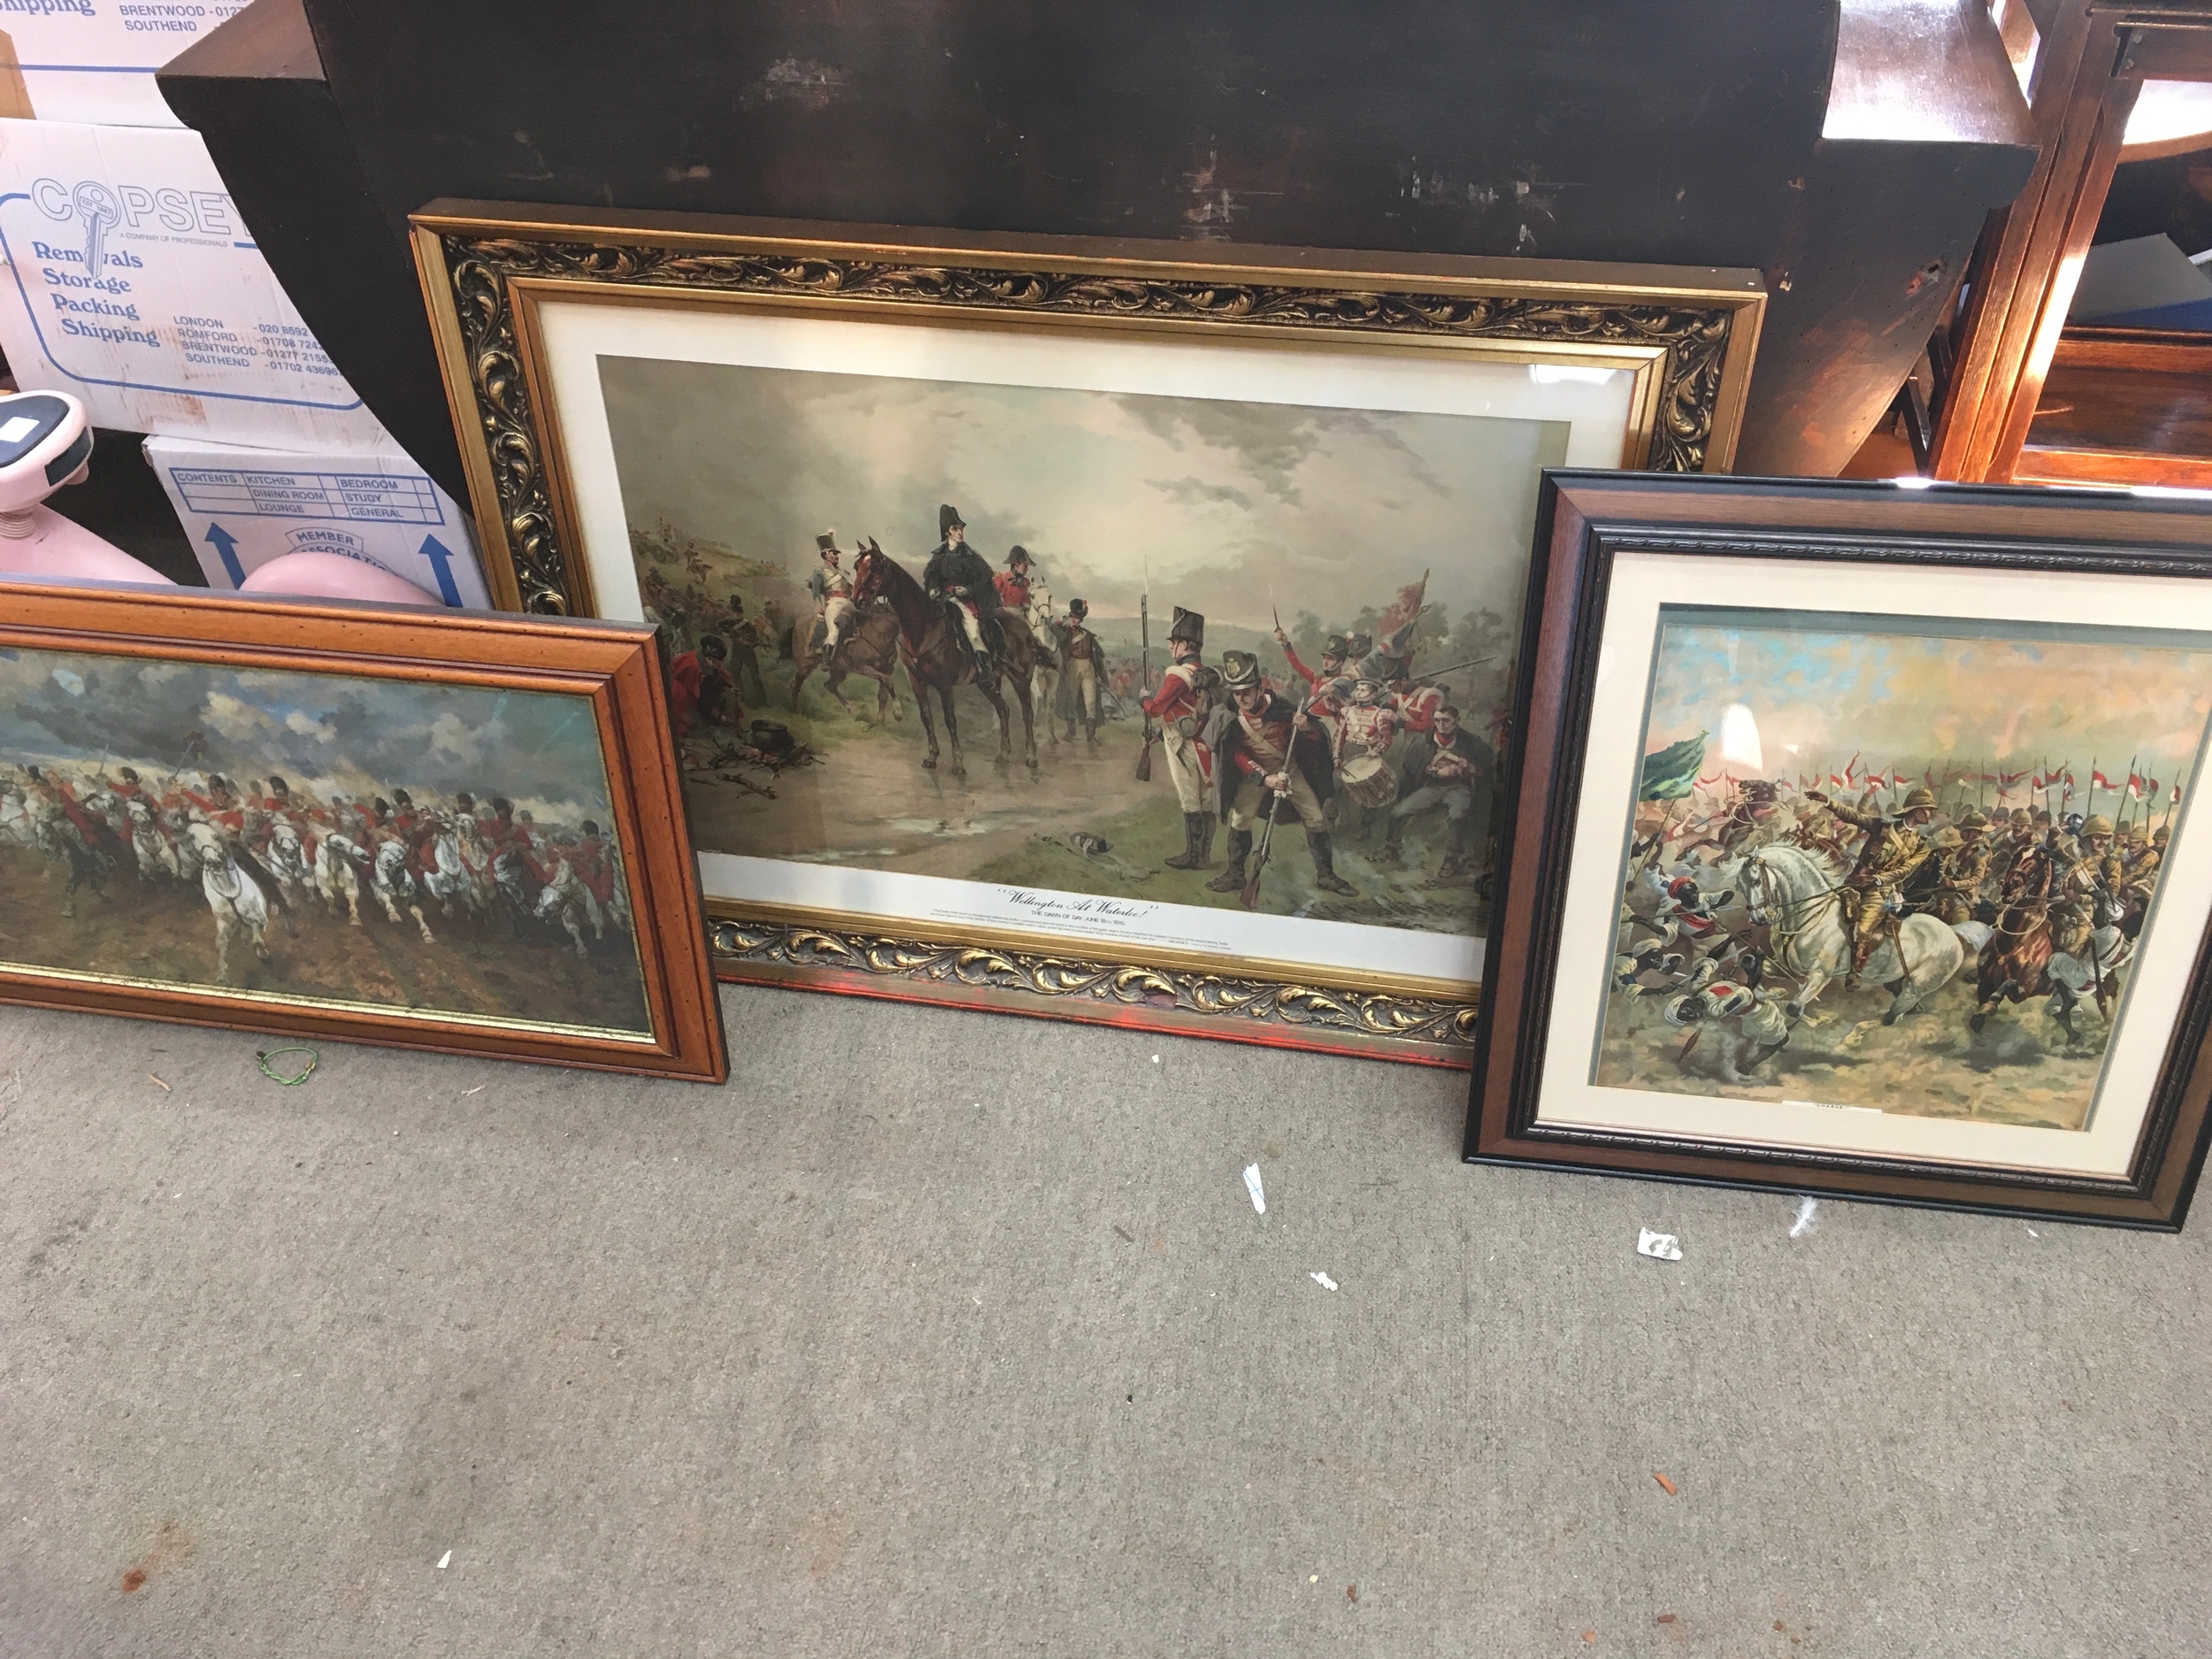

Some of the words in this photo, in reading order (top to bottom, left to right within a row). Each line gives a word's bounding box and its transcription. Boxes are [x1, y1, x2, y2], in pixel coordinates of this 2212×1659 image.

[119, 5, 205, 16] BRENTWOOD
[125, 20, 196, 31] SOUTHEND
[126, 233, 158, 242] COMPANY
[172, 236, 228, 247] PROFESSIONALS
[42, 267, 132, 295] Storage
[50, 293, 140, 321] Packing
[173, 315, 224, 328] LONDON
[61, 319, 160, 348] Shipping
[178, 328, 237, 342] ROMFORD
[182, 342, 257, 356] BRENTWOOD
[186, 353, 250, 367] SOUTHEND
[177, 472, 237, 483] CONTENTS
[246, 476, 296, 486] KITCHEN
[341, 479, 398, 489] BEDROOM
[253, 489, 290, 499] DINING
[292, 491, 324, 501] ROOM
[345, 494, 381, 503] STUDY
[259, 503, 304, 513] LOUNGE
[351, 507, 403, 518] GENERAL
[296, 531, 354, 545] MEMBER
